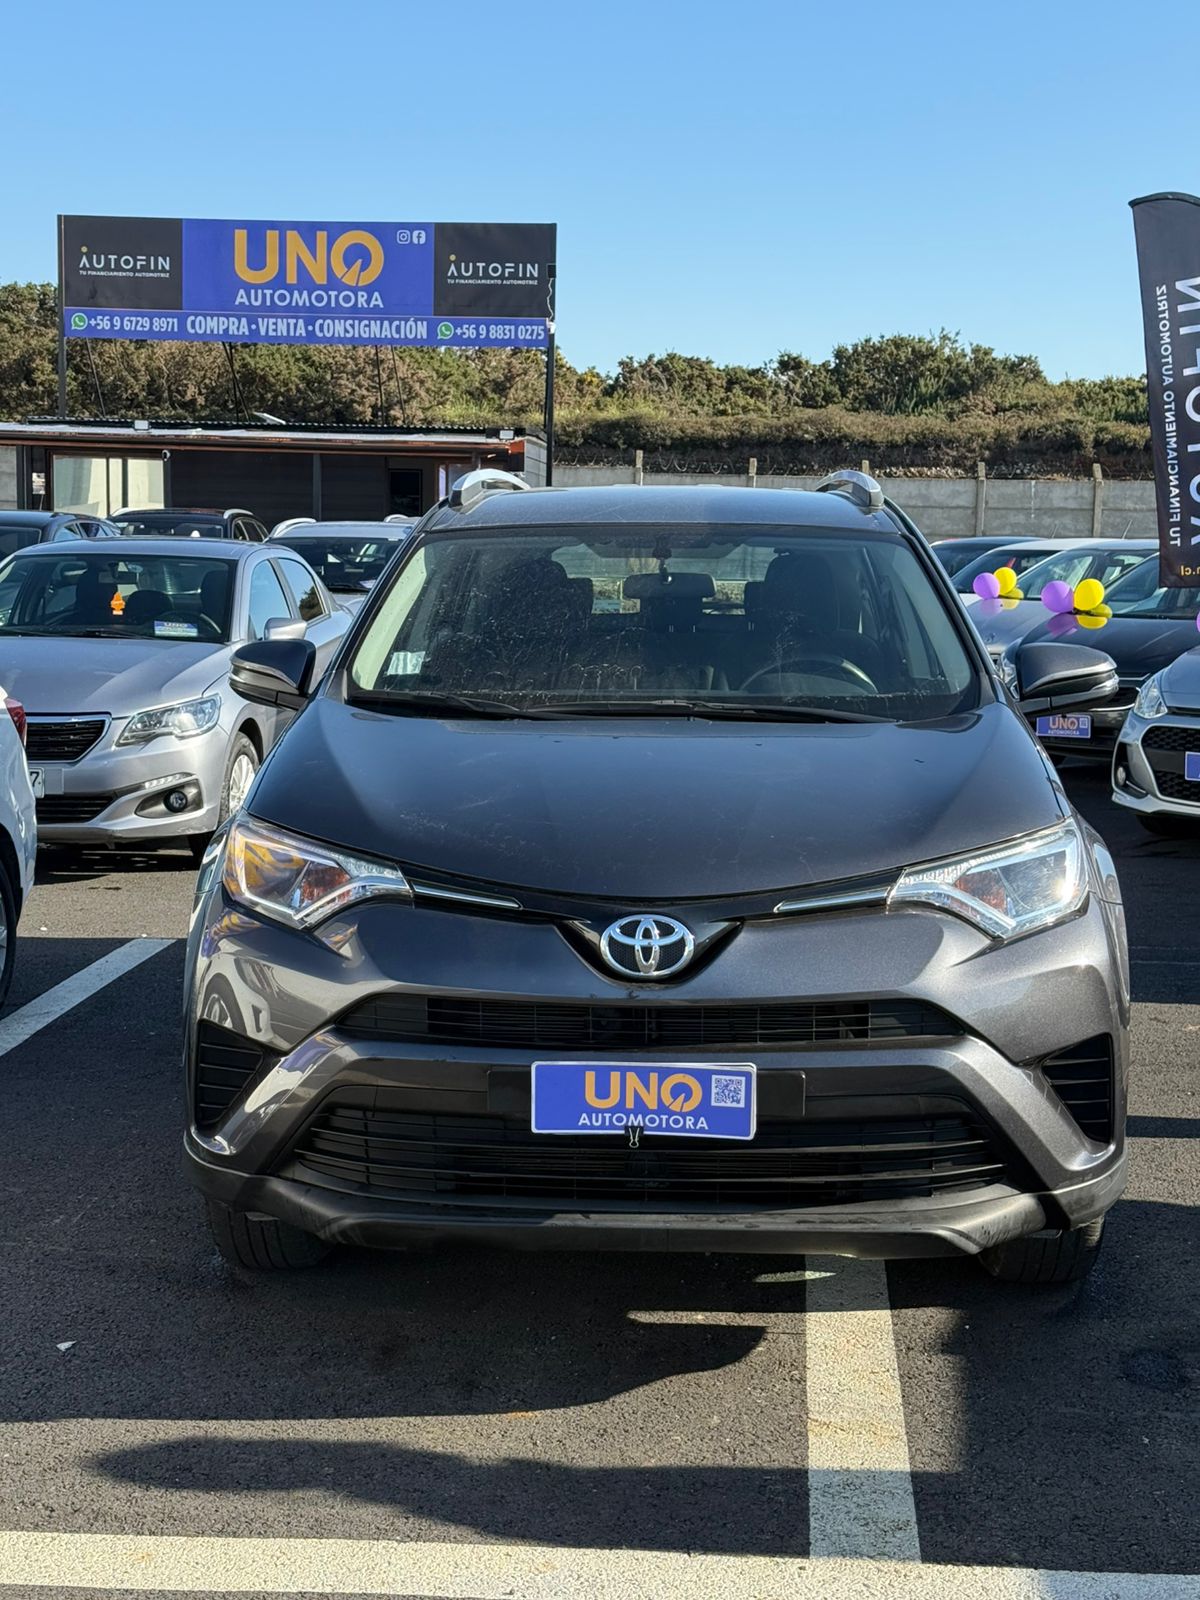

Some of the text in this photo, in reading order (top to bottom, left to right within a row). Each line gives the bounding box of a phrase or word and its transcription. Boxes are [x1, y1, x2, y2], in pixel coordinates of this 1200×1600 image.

[79, 253, 170, 271] AUTOFIN
[234, 229, 385, 287] UNO
[447, 262, 539, 278] AUTOFIN
[234, 288, 384, 308] AUTOMOTORA
[89, 315, 178, 332] +56 9 6729 8971
[455, 324, 545, 340] +56 9 8831 0275
[1049, 716, 1078, 729] UNO
[584, 1070, 703, 1113] UNO
[578, 1112, 709, 1130] AUTOMOTORA
